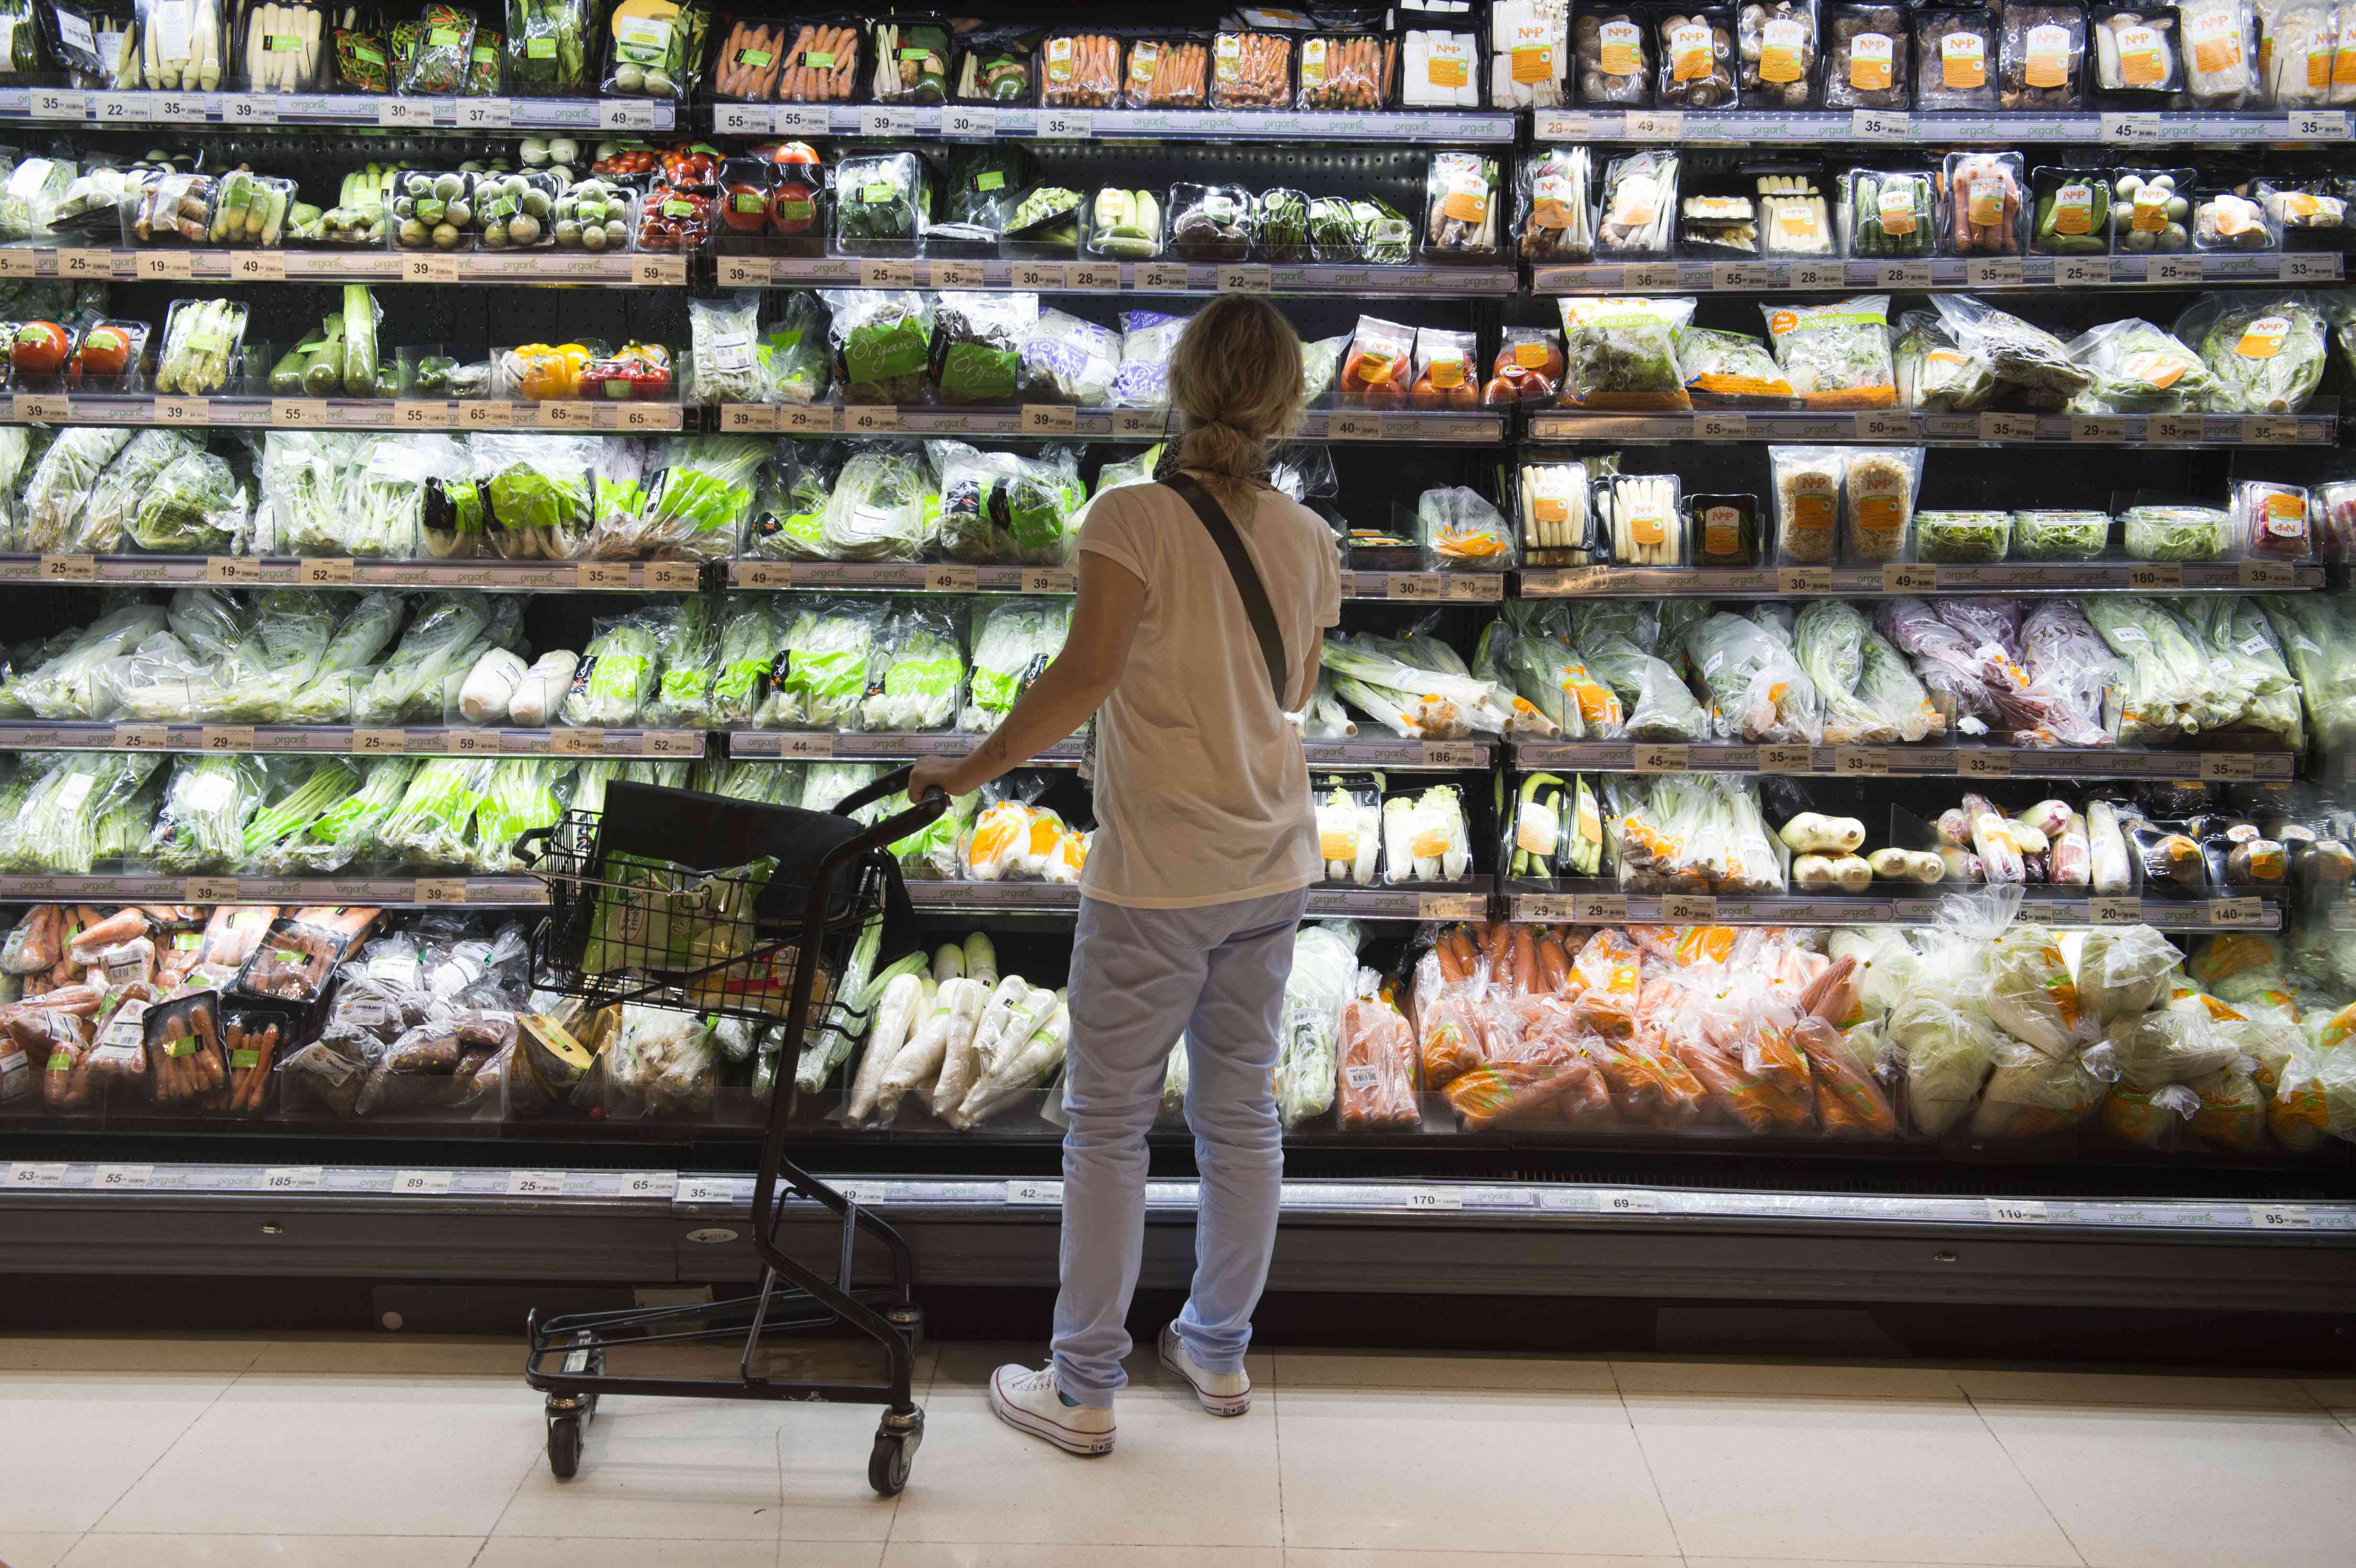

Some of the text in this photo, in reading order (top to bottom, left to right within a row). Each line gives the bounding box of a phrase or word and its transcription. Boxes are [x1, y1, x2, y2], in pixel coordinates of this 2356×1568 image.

[1518, 27, 1544, 39] N&P
[1607, 27, 1633, 37] N&P
[1679, 32, 1704, 42] N&P
[1950, 39, 1976, 49] N&P
[2125, 33, 2149, 44] N&P
[1436, 44, 1461, 54] N&P
[1859, 40, 1886, 50] N&P
[291, 98, 327, 110] organic
[1200, 116, 1235, 129] organic
[1460, 120, 1495, 134] organic
[2028, 123, 2064, 135] organic
[2062, 191, 2086, 200] N&P
[503, 258, 538, 272] organic
[2021, 261, 2055, 273] organic
[1335, 272, 1370, 283] organic
[1602, 316, 1655, 326] ORGANIC
[853, 328, 921, 374] Organic
[1386, 420, 1421, 433] organic
[1942, 419, 1976, 432] organic
[1802, 478, 1826, 488] N&P
[1867, 479, 1892, 490] N&P
[1712, 512, 1734, 521] N&P
[259, 568, 294, 580] organic
[811, 567, 845, 579] organic
[1945, 569, 1980, 582] organic
[275, 732, 308, 746] organic
[1375, 749, 1408, 761] organic
[1920, 752, 1955, 765] organic
[144, 881, 179, 893] organic
[1001, 887, 1035, 900] organic
[1780, 906, 1814, 918] organic
[217, 1175, 253, 1187] organic
[1560, 1198, 1596, 1209] organic
[2315, 1210, 2352, 1224] organic
[1223, 1407, 1231, 1416] ALL
